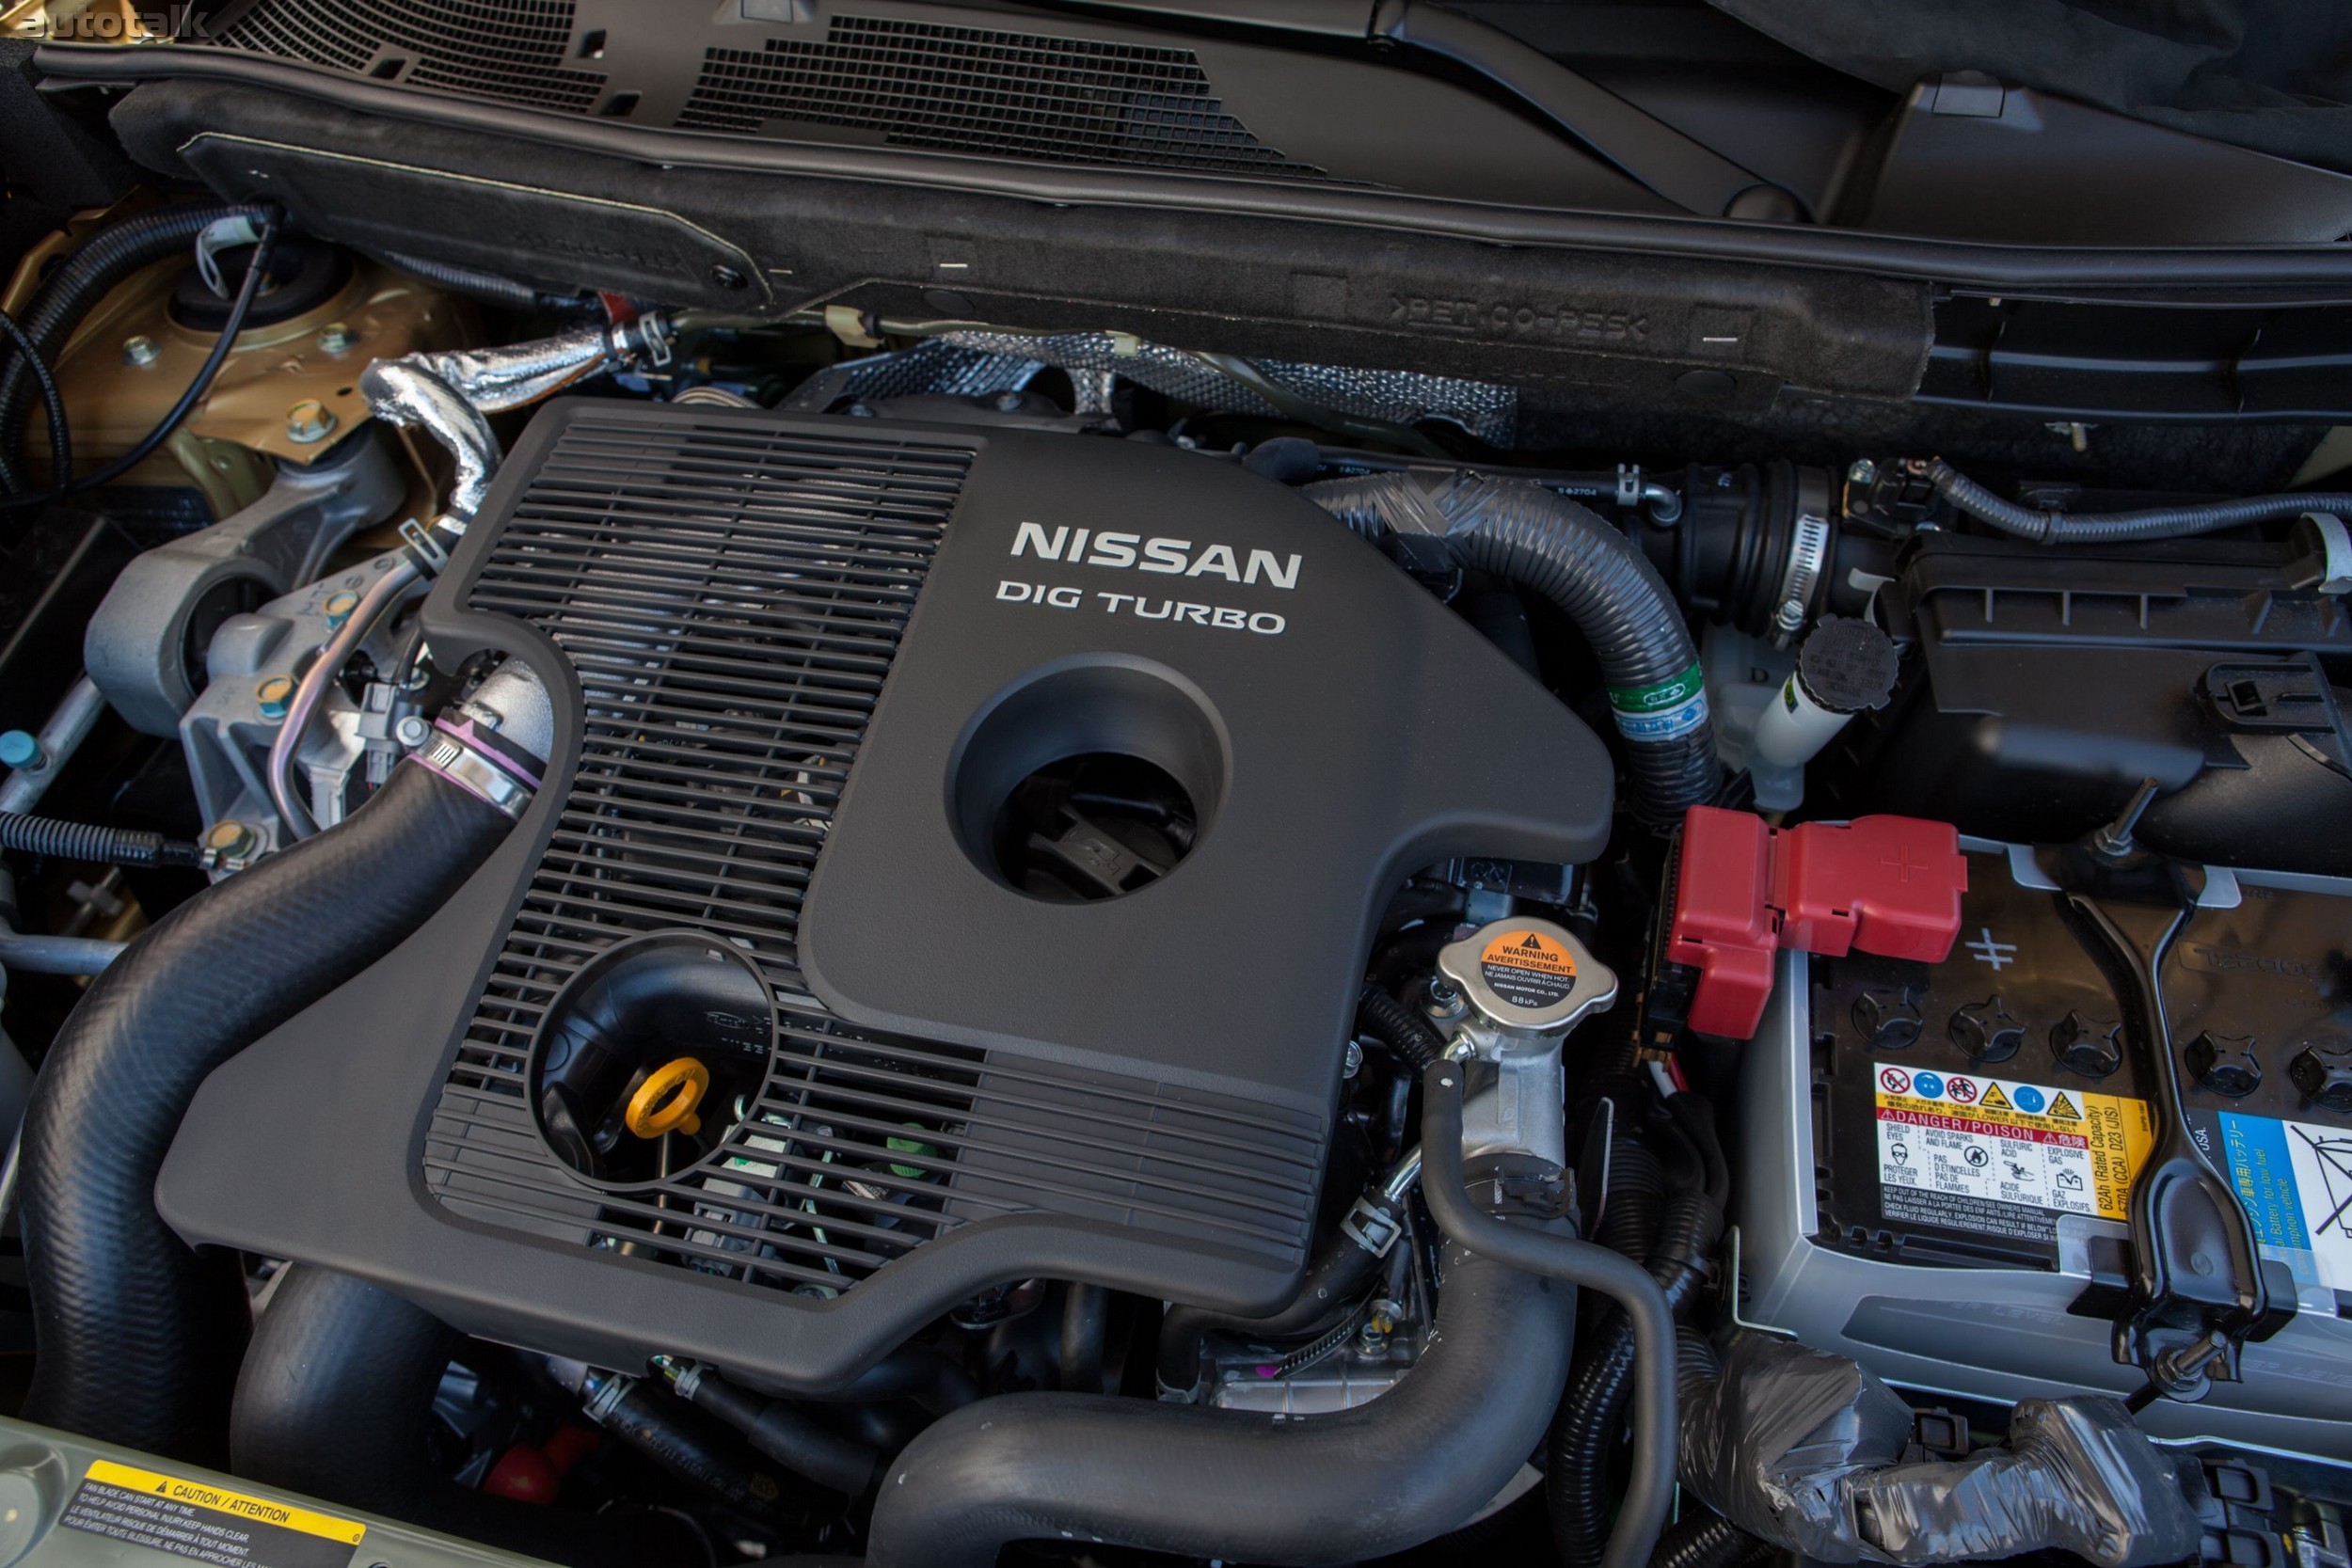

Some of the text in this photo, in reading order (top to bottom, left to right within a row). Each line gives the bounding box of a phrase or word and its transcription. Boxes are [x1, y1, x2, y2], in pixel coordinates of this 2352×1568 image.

[1009, 521, 1303, 590] NISSAN
[995, 579, 1286, 634] DIG TURBO
[1502, 945, 1559, 962] WARNING
[1487, 954, 1572, 974] AVERTISSEMENT
[1487, 964, 1510, 973] NEVER
[1511, 967, 1531, 976] OPEN
[1531, 971, 1553, 981] WHEN
[1494, 972, 1517, 981] JAMAIS
[1517, 976, 1541, 985] OUVRIR
[1516, 985, 1535, 993] MOTOR
[1897, 1111, 2034, 1141] DANGER/POISON
[2105, 1107, 2119, 1130] (JIS)
[1886, 1123, 1910, 1133] SHIELD
[1886, 1132, 1903, 1141] EYES
[1926, 1129, 1973, 1143] AVOID SPARKS
[2058, 1134, 2086, 1148] 危険
[2108, 1132, 2123, 1151] D23
[1926, 1138, 1963, 1150] AND FLAME
[2000, 1139, 2033, 1151] SULFURIC
[1934, 1154, 1947, 1164] PAS
[2001, 1148, 2017, 1158] ACID
[2047, 1147, 2084, 1160] EXPLOSIVE
[2049, 1155, 2063, 1165] GAS
[2085, 1105, 2113, 1211] 62Ah (Rated Capacity)
[2253, 1148, 2267, 1165] fuel
[1883, 1164, 1918, 1177] PROTEGER
[1884, 1173, 1897, 1182] LES
[1935, 1172, 1959, 1182] PAS DE
[2111, 1157, 2128, 1185] (CCA)
[2260, 1168, 2271, 1187] low
[1936, 1180, 1969, 1194] FLAMMES
[2000, 1181, 2020, 1192] ACIDE
[2052, 1189, 2066, 1199] GAZ
[2264, 1187, 2275, 1200] for
[1883, 1185, 1897, 1194] KEEP
[1898, 1187, 1909, 1196] OUT
[1917, 1190, 1929, 1198] THE
[1930, 1192, 1947, 1201] REACH
[1996, 1202, 2021, 1212] OWNERS
[1892, 1194, 1903, 1202] PAS
[1904, 1196, 1927, 1205] LAISSER
[2001, 1191, 2043, 1205] SULFURIQUE
[2278, 1179, 2292, 1211] vehicle
[1883, 1201, 1901, 1211] CHECK
[1902, 1204, 1919, 1212] FLUID
[1954, 1212, 1985, 1223] EXPLOSION
[1985, 1216, 1997, 1225] CAN
[1998, 1218, 2019, 1227] RESULT
[1883, 1209, 1909, 1219] VERIFIER
[1917, 1214, 1939, 1224] LIQUIDE
[2267, 1202, 2283, 1235] Battery
[83, 1481, 98, 1492] FAN
[96, 1485, 119, 1497] BLADE
[119, 1491, 135, 1501] CAN
[134, 1495, 155, 1506] START
[153, 1499, 165, 1509] AT
[162, 1501, 179, 1513] ANY
[173, 1484, 222, 1505] CAUTION
[229, 1499, 291, 1523] ATTENTION
[78, 1493, 88, 1502] TO
[87, 1495, 106, 1507] HELP
[104, 1499, 127, 1512] AVOID
[124, 1504, 160, 1520] PERSONAL
[199, 1523, 226, 1536] HANDS
[70, 1504, 80, 1513] LE
[79, 1507, 121, 1524] VENTILATEUR
[119, 1517, 146, 1530] RISQUE
[145, 1523, 156, 1533] DE
[155, 1525, 195, 1543] DÉMARRER
[192, 1533, 200, 1543] À
[199, 1537, 218, 1548] TOUT
[63, 1515, 84, 1526] POUR
[105, 1525, 129, 1538] TOUTE
[162, 1541, 175, 1550] NE
[173, 1543, 188, 1553] PAS
[187, 1547, 199, 1556] EN
[198, 1549, 243, 1567] APPROCHER
